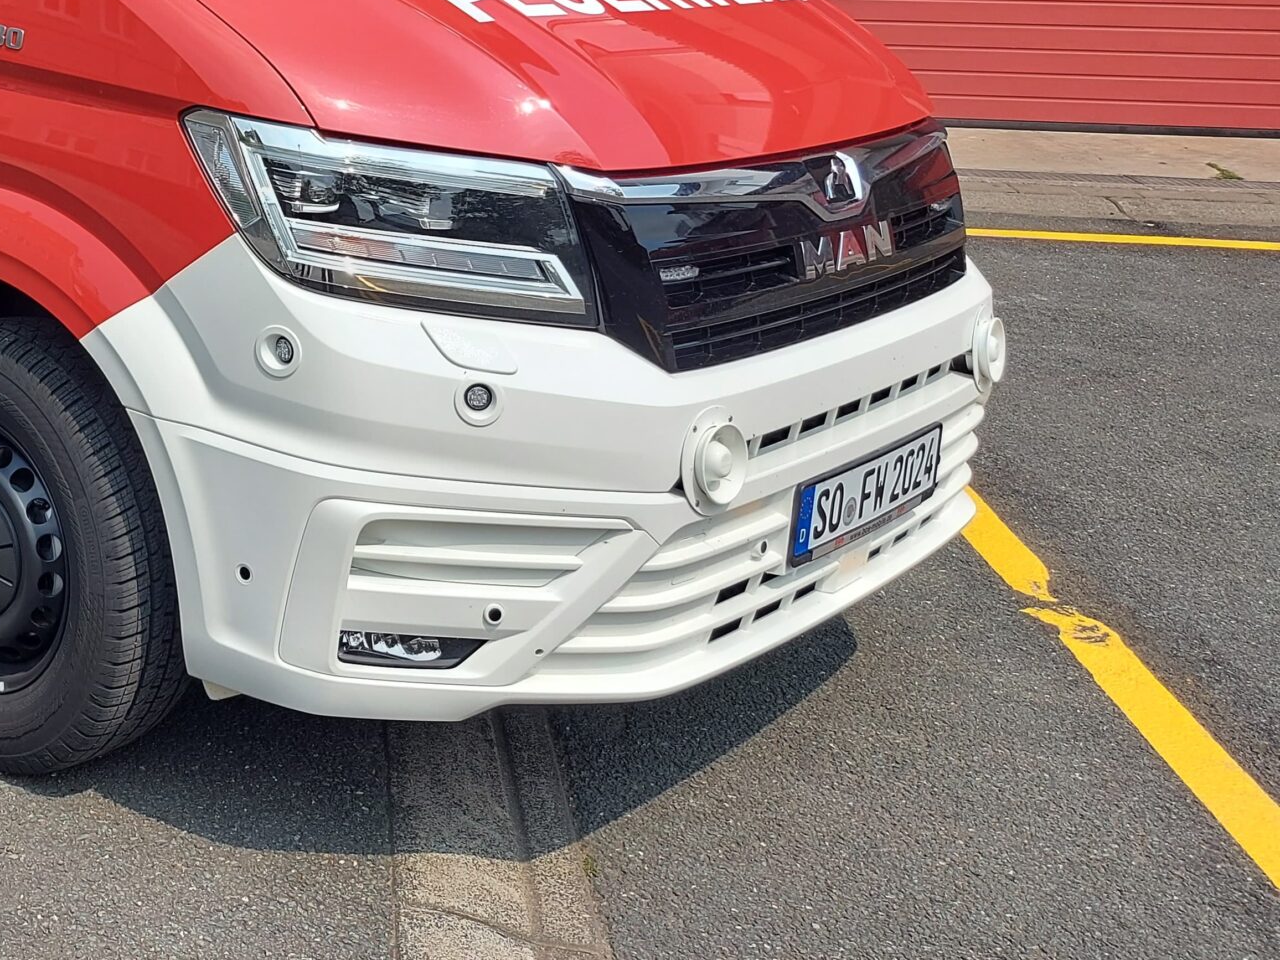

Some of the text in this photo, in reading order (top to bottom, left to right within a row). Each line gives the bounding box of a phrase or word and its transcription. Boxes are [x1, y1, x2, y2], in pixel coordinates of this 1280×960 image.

[799, 220, 893, 281] MAN
[813, 437, 935, 540] SO FW 2024
[799, 528, 806, 543] D
